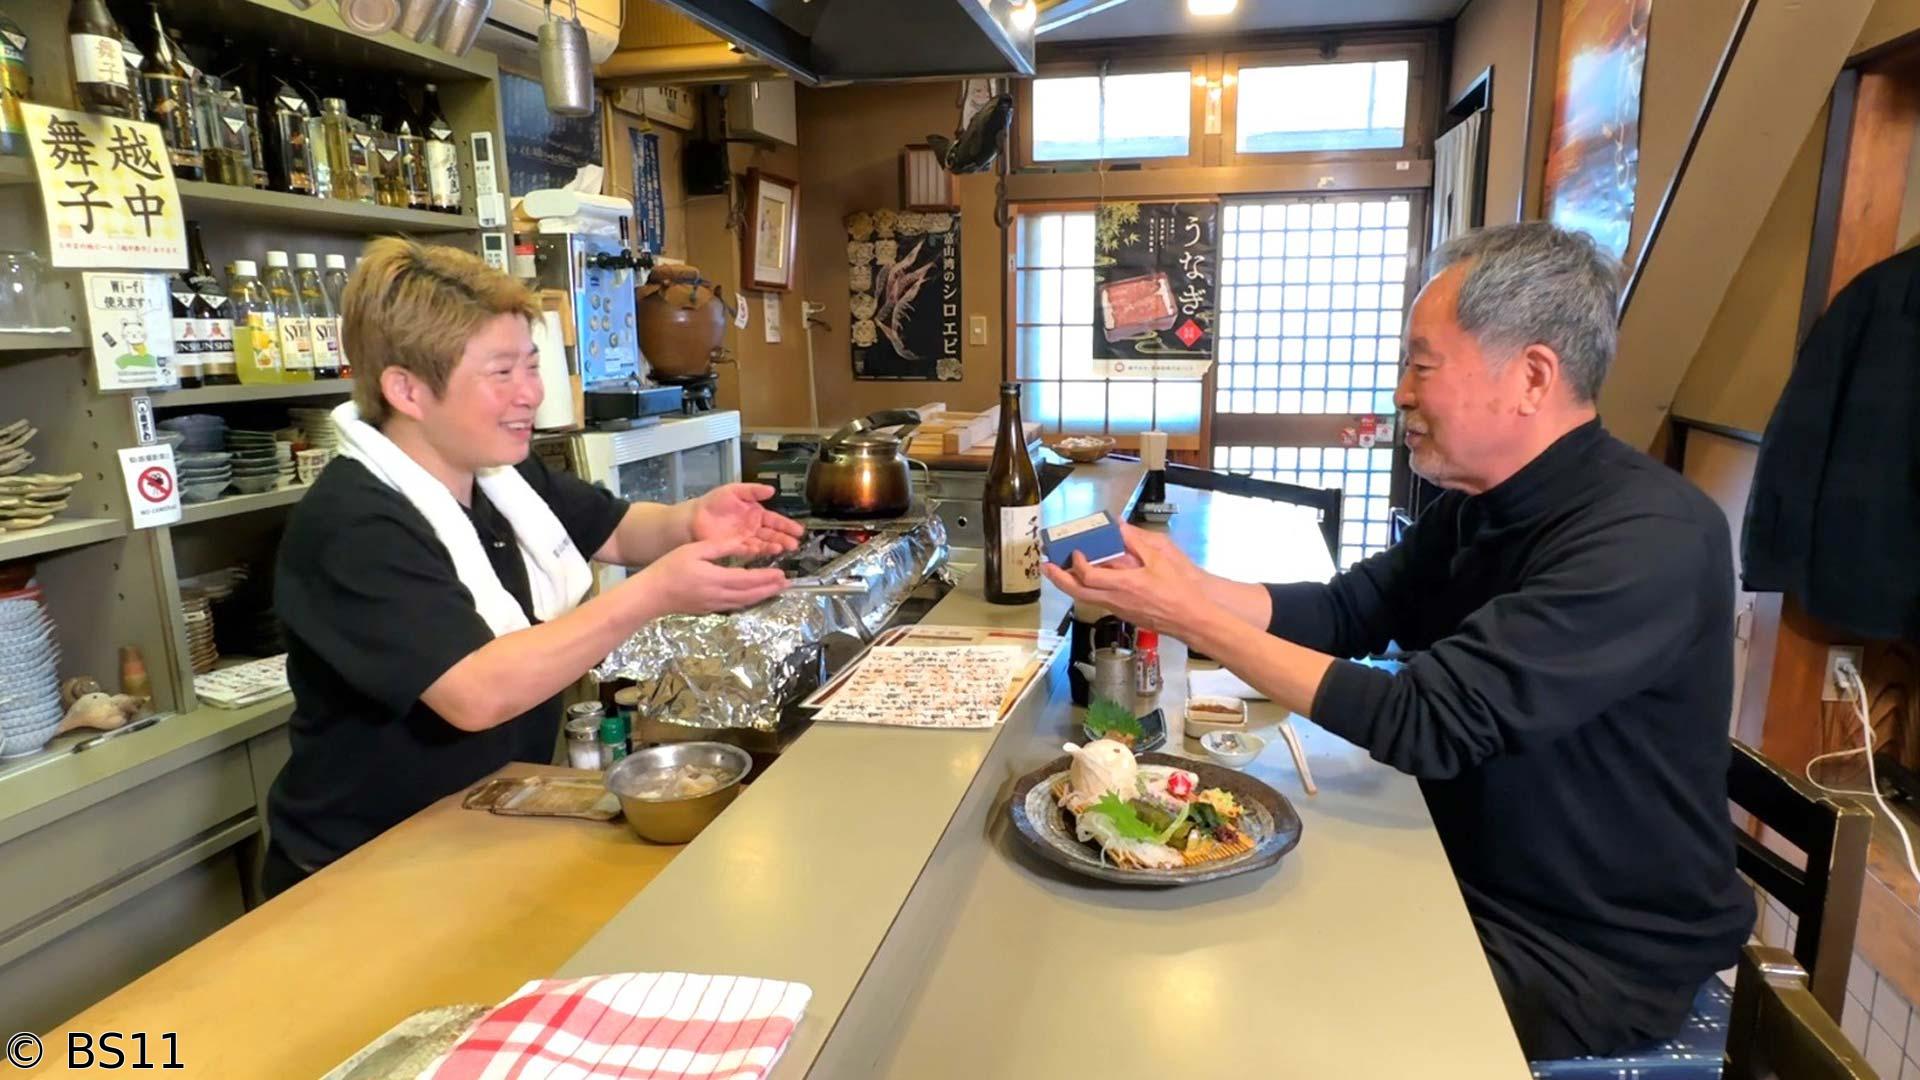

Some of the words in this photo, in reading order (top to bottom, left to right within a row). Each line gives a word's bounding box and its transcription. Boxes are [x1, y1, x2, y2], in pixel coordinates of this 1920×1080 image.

[42, 114, 113, 235] 舞子
[107, 125, 165, 238] 越中
[942, 232, 958, 354] 富山湾のシロエビ
[1178, 215, 1206, 316] うなぎ
